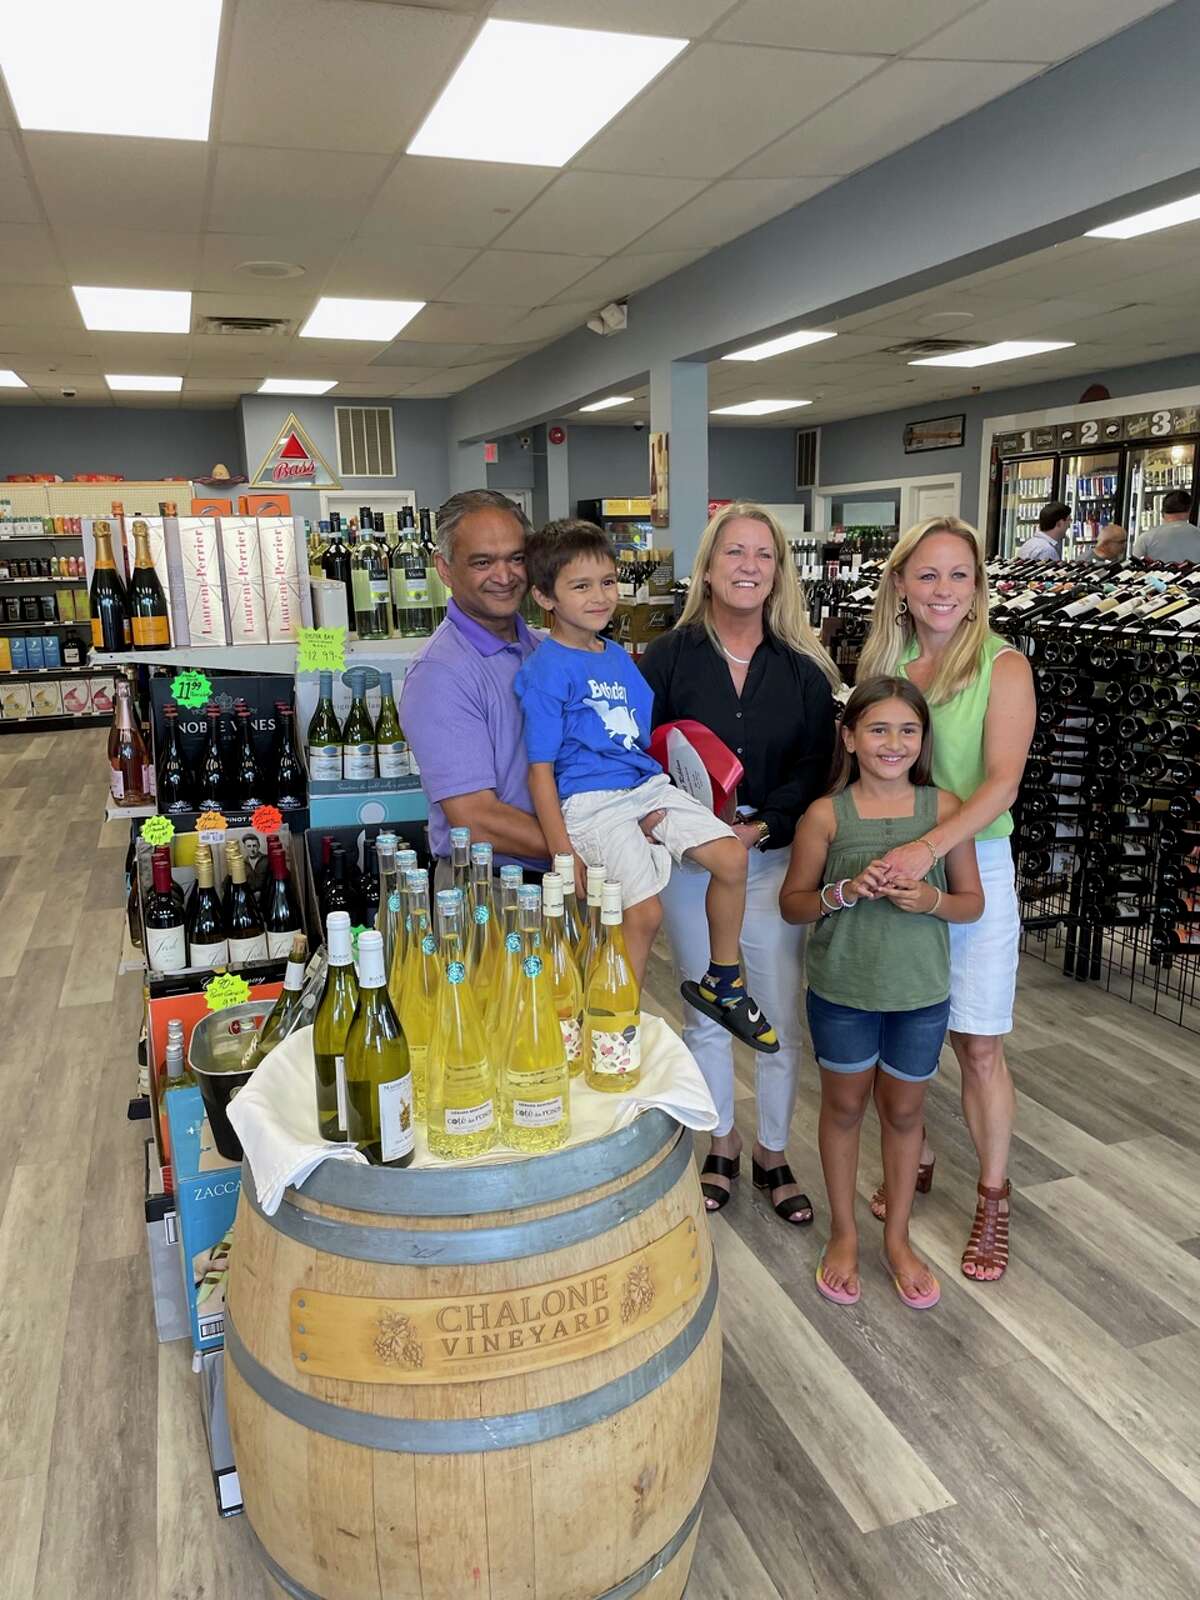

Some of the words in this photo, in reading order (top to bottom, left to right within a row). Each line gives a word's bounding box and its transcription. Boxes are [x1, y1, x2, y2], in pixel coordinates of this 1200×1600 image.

[1021, 431, 1034, 452] 1
[1080, 421, 1099, 445] 2
[1150, 410, 1171, 437] 3
[272, 461, 316, 481] Bass
[194, 529, 212, 634] Laurent-Perrier
[236, 529, 254, 632] Laurent-Perrier
[273, 528, 290, 631] Laurent-Perrier
[178, 720, 226, 734] NOBE
[230, 718, 276, 732] VNES
[435, 1273, 609, 1333] CHALONE
[440, 1305, 611, 1357] VINEYARD
